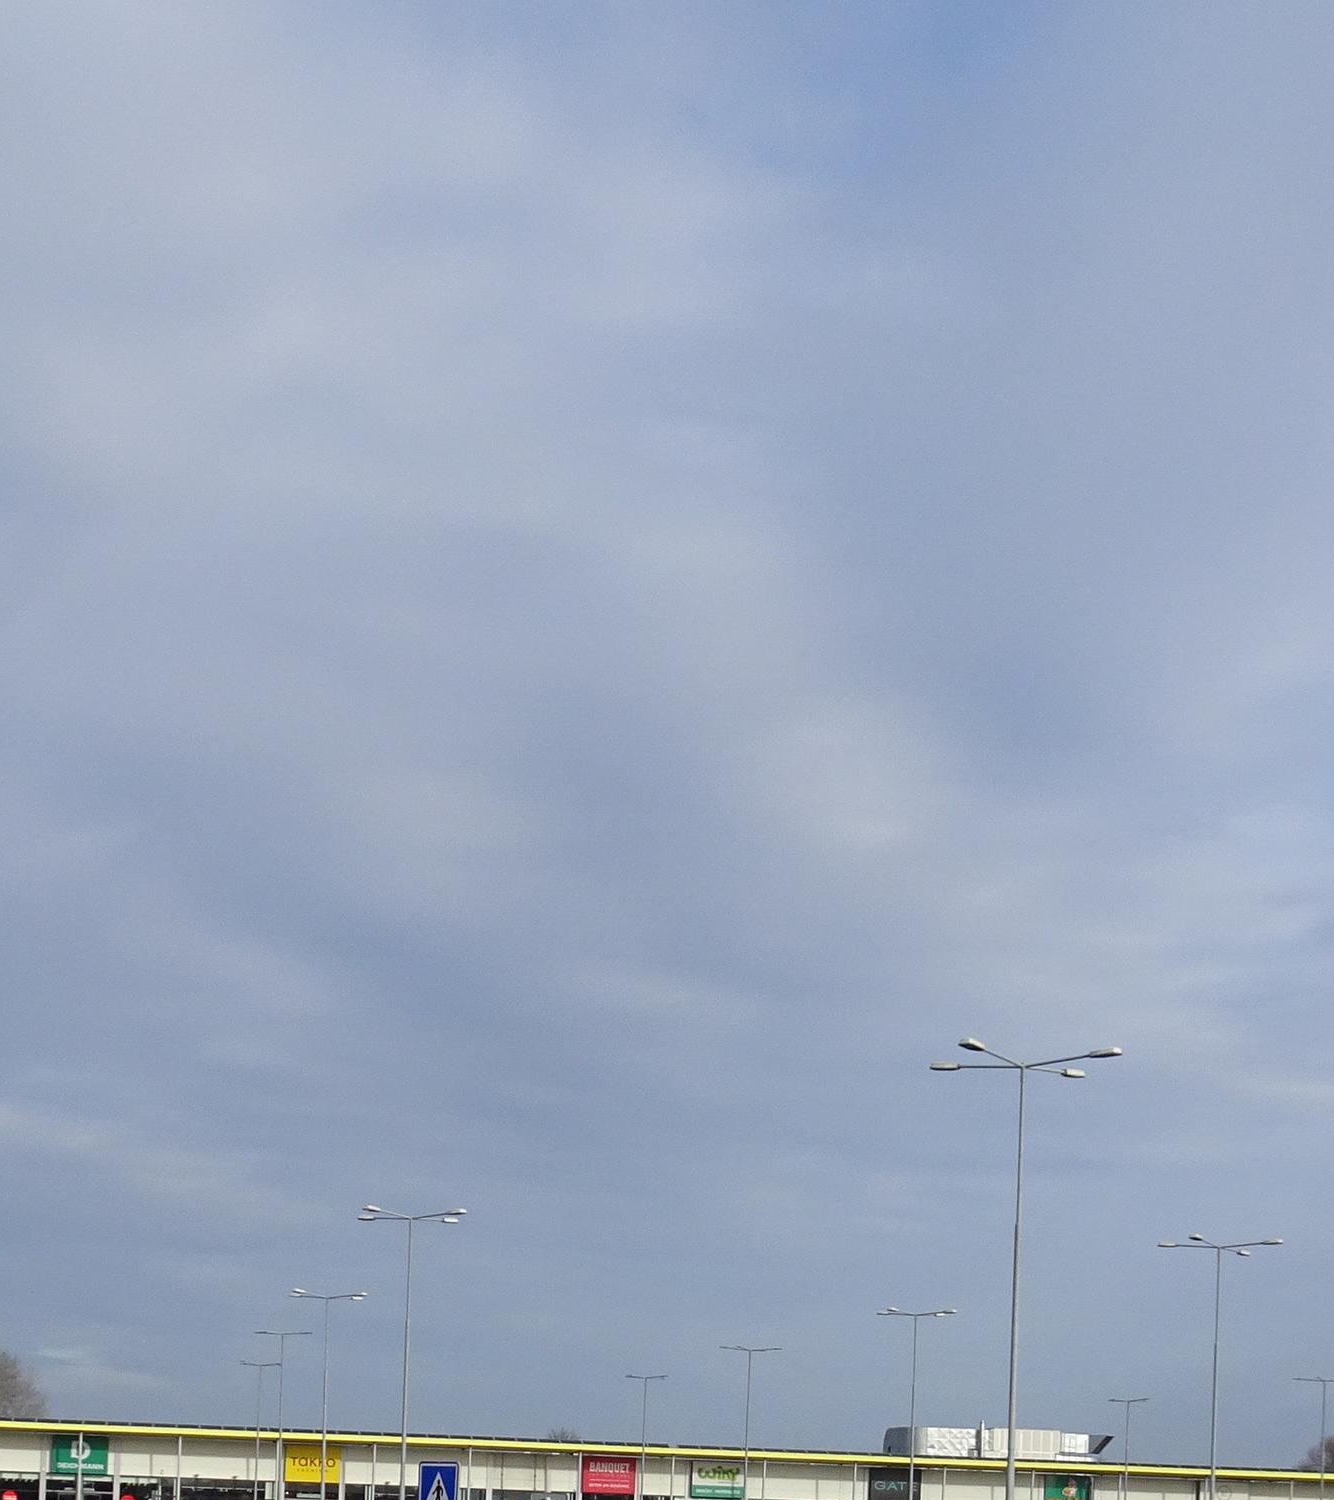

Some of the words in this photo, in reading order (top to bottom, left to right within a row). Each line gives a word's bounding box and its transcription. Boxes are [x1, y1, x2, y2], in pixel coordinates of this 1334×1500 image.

[70, 1441, 91, 1460] D
[589, 1462, 630, 1474] BANQUET
[874, 1481, 918, 1491] GATE
